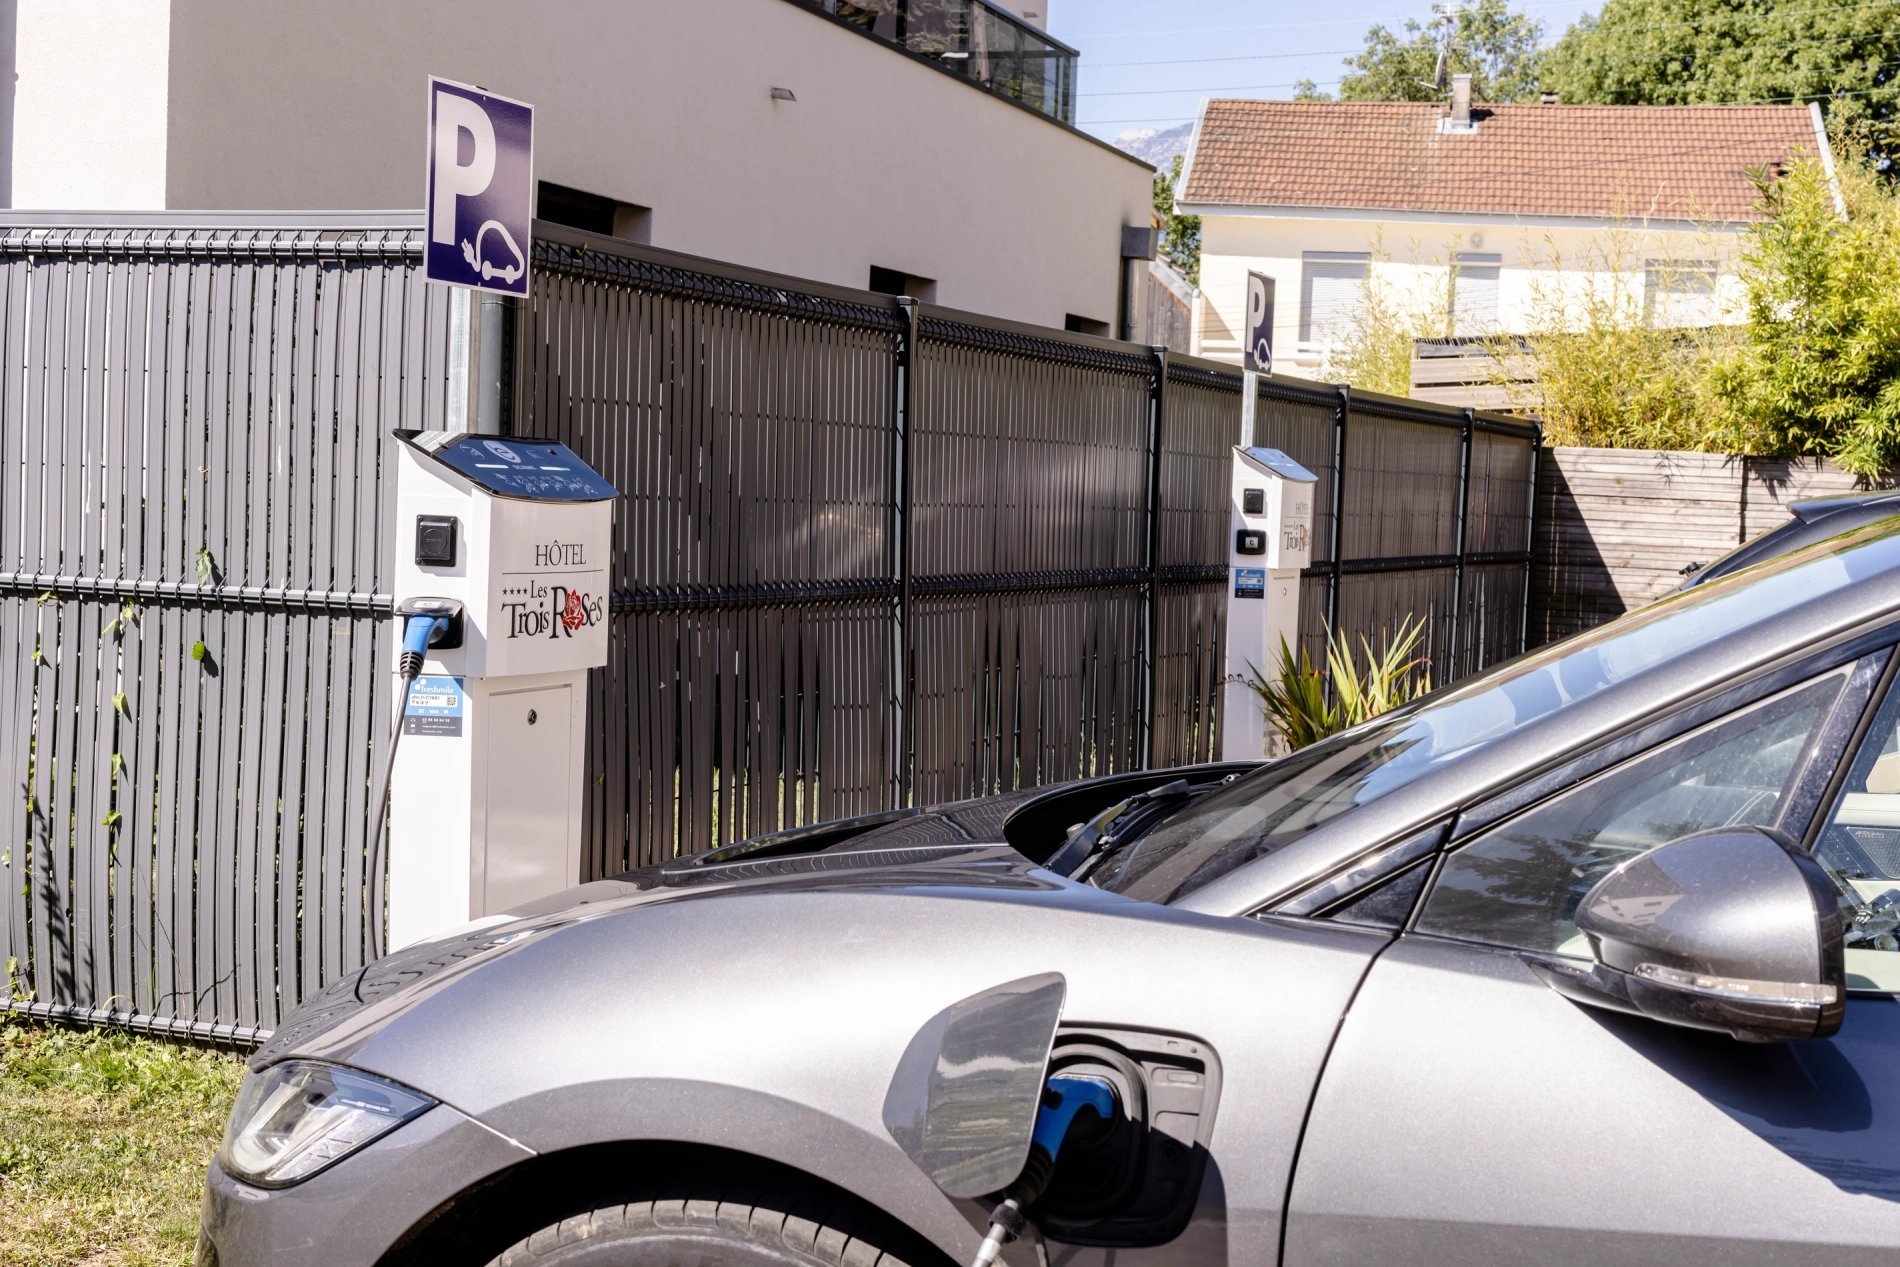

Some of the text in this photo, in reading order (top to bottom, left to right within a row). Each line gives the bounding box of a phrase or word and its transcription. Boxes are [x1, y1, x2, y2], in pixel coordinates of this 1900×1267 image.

[433, 90, 497, 246] P
[1246, 275, 1266, 353] P
[535, 540, 586, 566] HÔTEL
[530, 580, 548, 599] Les
[500, 601, 550, 639] Trois
[422, 686, 454, 694] freshmile
